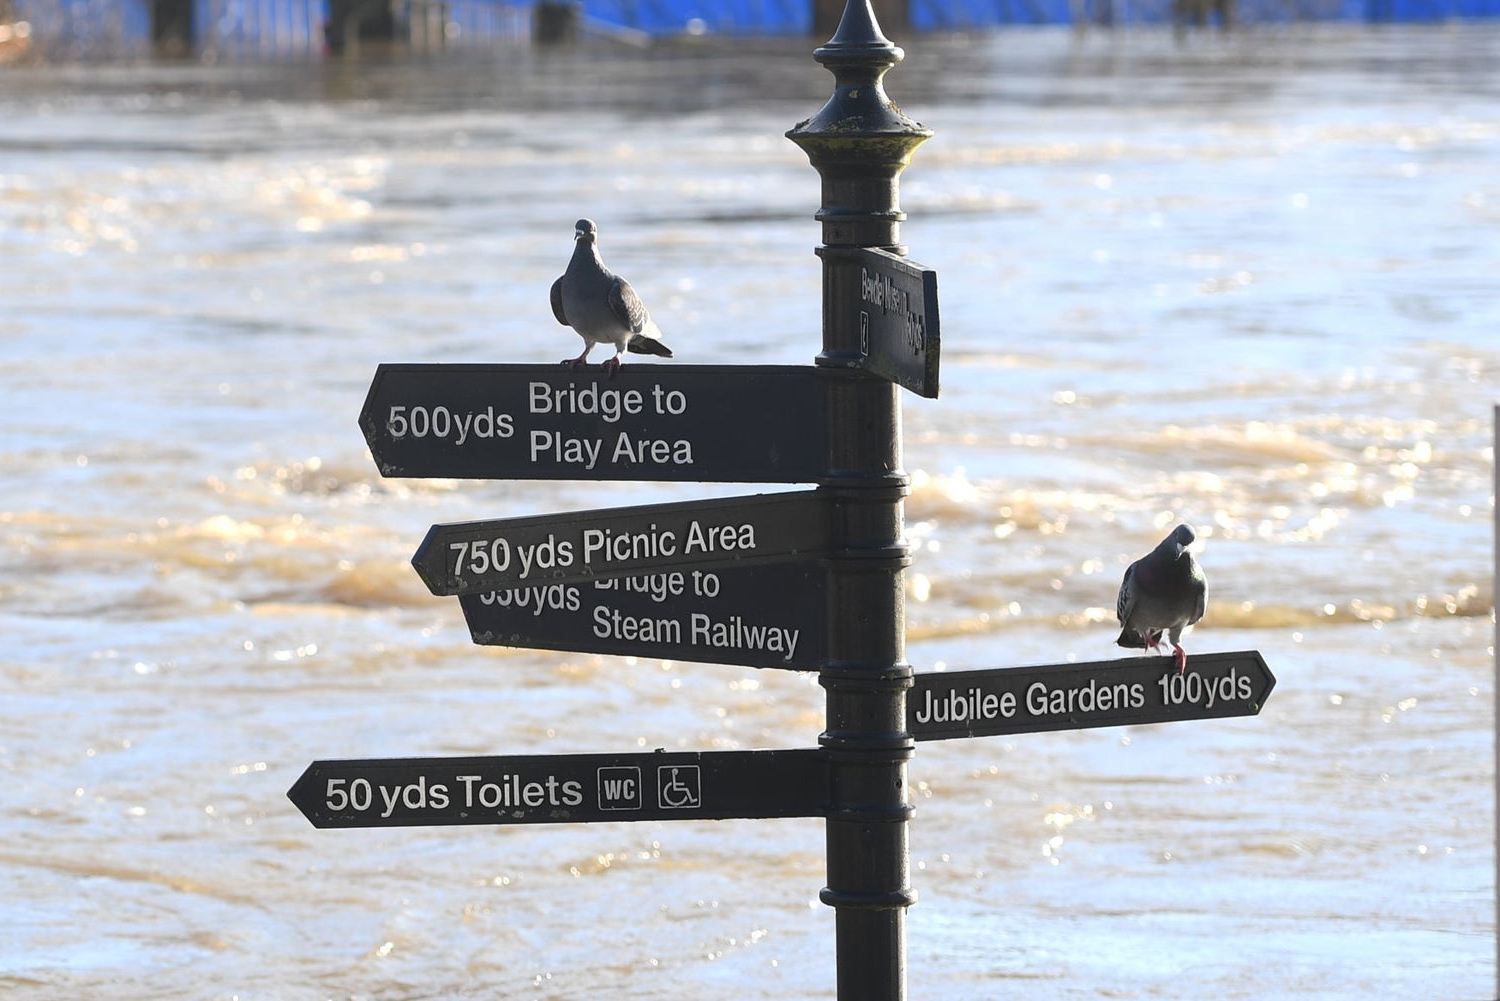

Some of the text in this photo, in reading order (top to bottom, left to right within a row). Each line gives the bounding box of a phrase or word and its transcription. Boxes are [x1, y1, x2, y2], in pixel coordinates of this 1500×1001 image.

[530, 382, 686, 422] Bridge to
[389, 406, 513, 445] 500yds
[531, 431, 693, 469] Play Area
[450, 521, 755, 578] 750 yds Picnic Area
[692, 571, 719, 597] to
[594, 606, 798, 659] Steam Railway
[917, 667, 1251, 723] Jubilee Gardens 100yds
[327, 775, 634, 817] 50 yds Toilets WC
